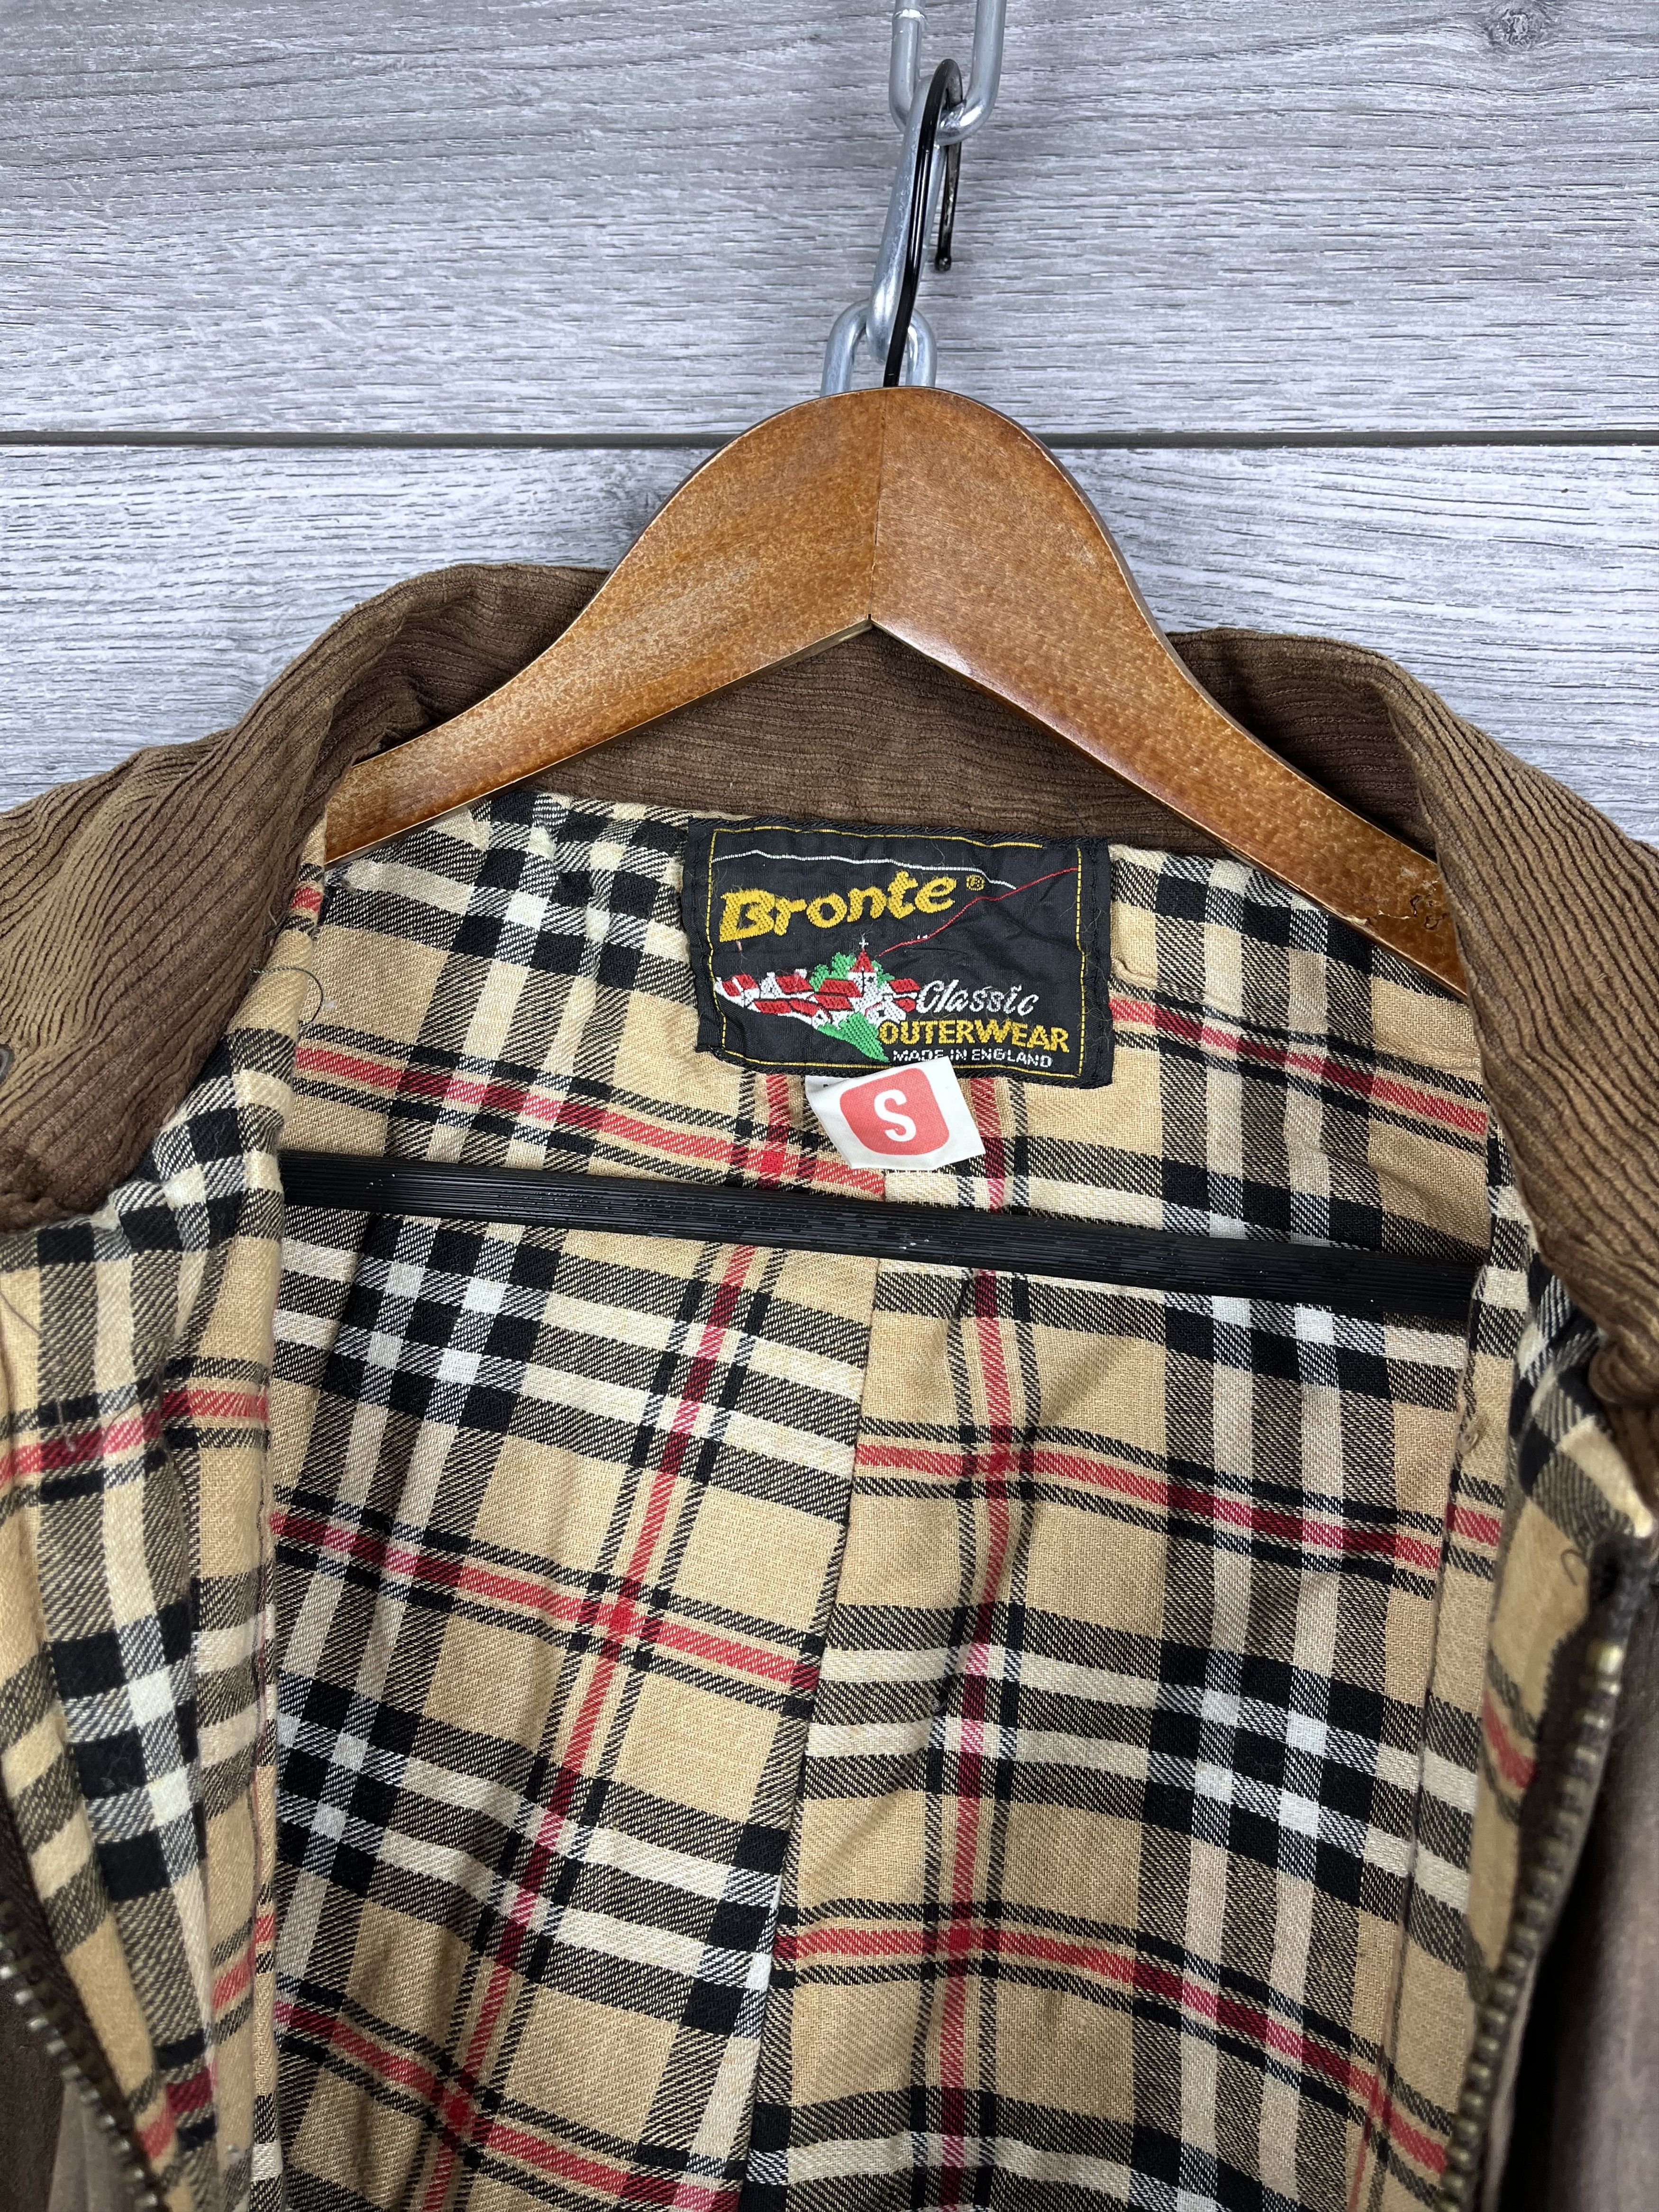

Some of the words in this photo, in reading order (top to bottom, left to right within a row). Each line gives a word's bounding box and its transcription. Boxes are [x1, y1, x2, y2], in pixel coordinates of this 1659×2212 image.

[719, 870, 957, 942] Bronte
[916, 979, 1039, 1016] Classic
[879, 1019, 1070, 1053] OUTERWEAR
[893, 1049, 944, 1062] MADE
[950, 1048, 967, 1061] IN
[971, 1048, 1053, 1068] ENGLAND
[874, 1089, 918, 1142] S
